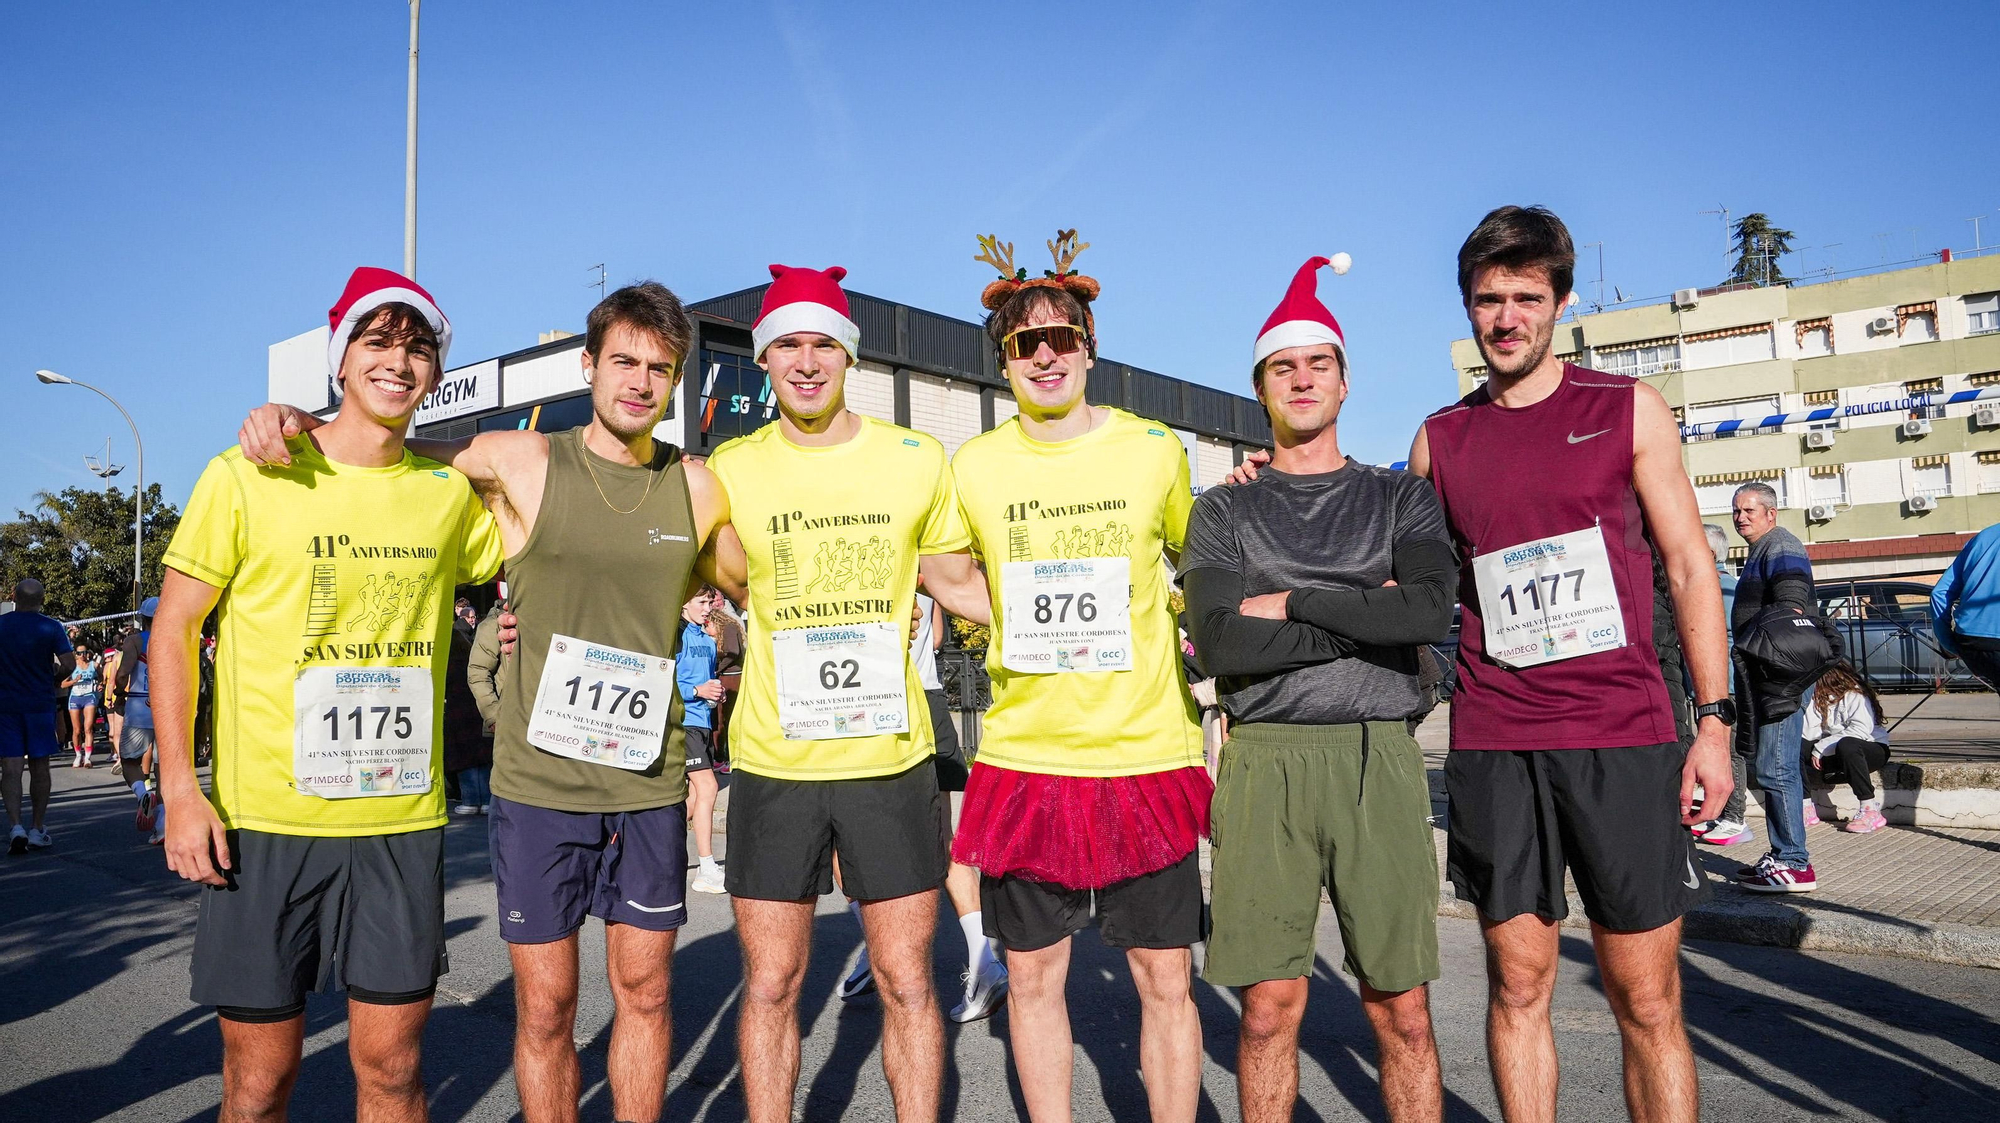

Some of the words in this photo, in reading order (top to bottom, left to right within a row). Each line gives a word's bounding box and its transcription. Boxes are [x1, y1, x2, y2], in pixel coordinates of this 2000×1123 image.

[730, 395, 750, 414] SG
[1845, 400, 1892, 417] POLICIA
[1895, 394, 1935, 411] LOCAL
[421, 408, 457, 422] TOGETHER
[1038, 499, 1127, 520] ANIVERSARIO
[802, 513, 891, 531] ANIVERSARIO
[349, 546, 437, 559] ANIVERSARIO
[1500, 568, 1586, 616] 1177
[774, 605, 802, 621] SAN
[805, 599, 894, 618] SILVESTRE
[1034, 592, 1098, 624] 876
[1506, 624, 1520, 633] SAN
[1522, 613, 1564, 630] SILVESTRE
[1565, 605, 1616, 619] CORDOBESA
[1529, 626, 1545, 635] FRAN
[1545, 622, 1561, 632] PREZ
[1562, 618, 1586, 628] BLANCO
[1039, 630, 1080, 639] SILVESTRE
[1081, 629, 1127, 637] CORDOBESA
[1592, 628, 1612, 638] GCC
[303, 643, 340, 662] SAN
[344, 641, 436, 660] SILVESTRE
[1018, 653, 1052, 661] IMDECO
[1503, 643, 1538, 658] IMDECO
[335, 676, 401, 684] populares
[819, 658, 862, 690] 62
[565, 675, 650, 720] 1176
[800, 699, 814, 707] SAN
[815, 696, 856, 705] SILVESTRE
[857, 692, 903, 701] CORDOBESA
[323, 706, 413, 741] 1175
[557, 711, 572, 720] SAN
[573, 715, 615, 730] SILVESTRE
[615, 724, 659, 738] CORDOBESA
[795, 719, 829, 729] IMDECO
[879, 714, 897, 722] GCC
[544, 731, 580, 746] IMDECO
[573, 724, 597, 733] ALBERTO
[615, 732, 635, 740] BLANCO
[321, 750, 339, 758] SAN
[340, 748, 385, 758] SILVESTRE
[386, 747, 428, 756] CORDOBESA
[629, 750, 648, 759] GCC
[314, 774, 353, 784] IMDECO
[404, 771, 420, 780] GCC
